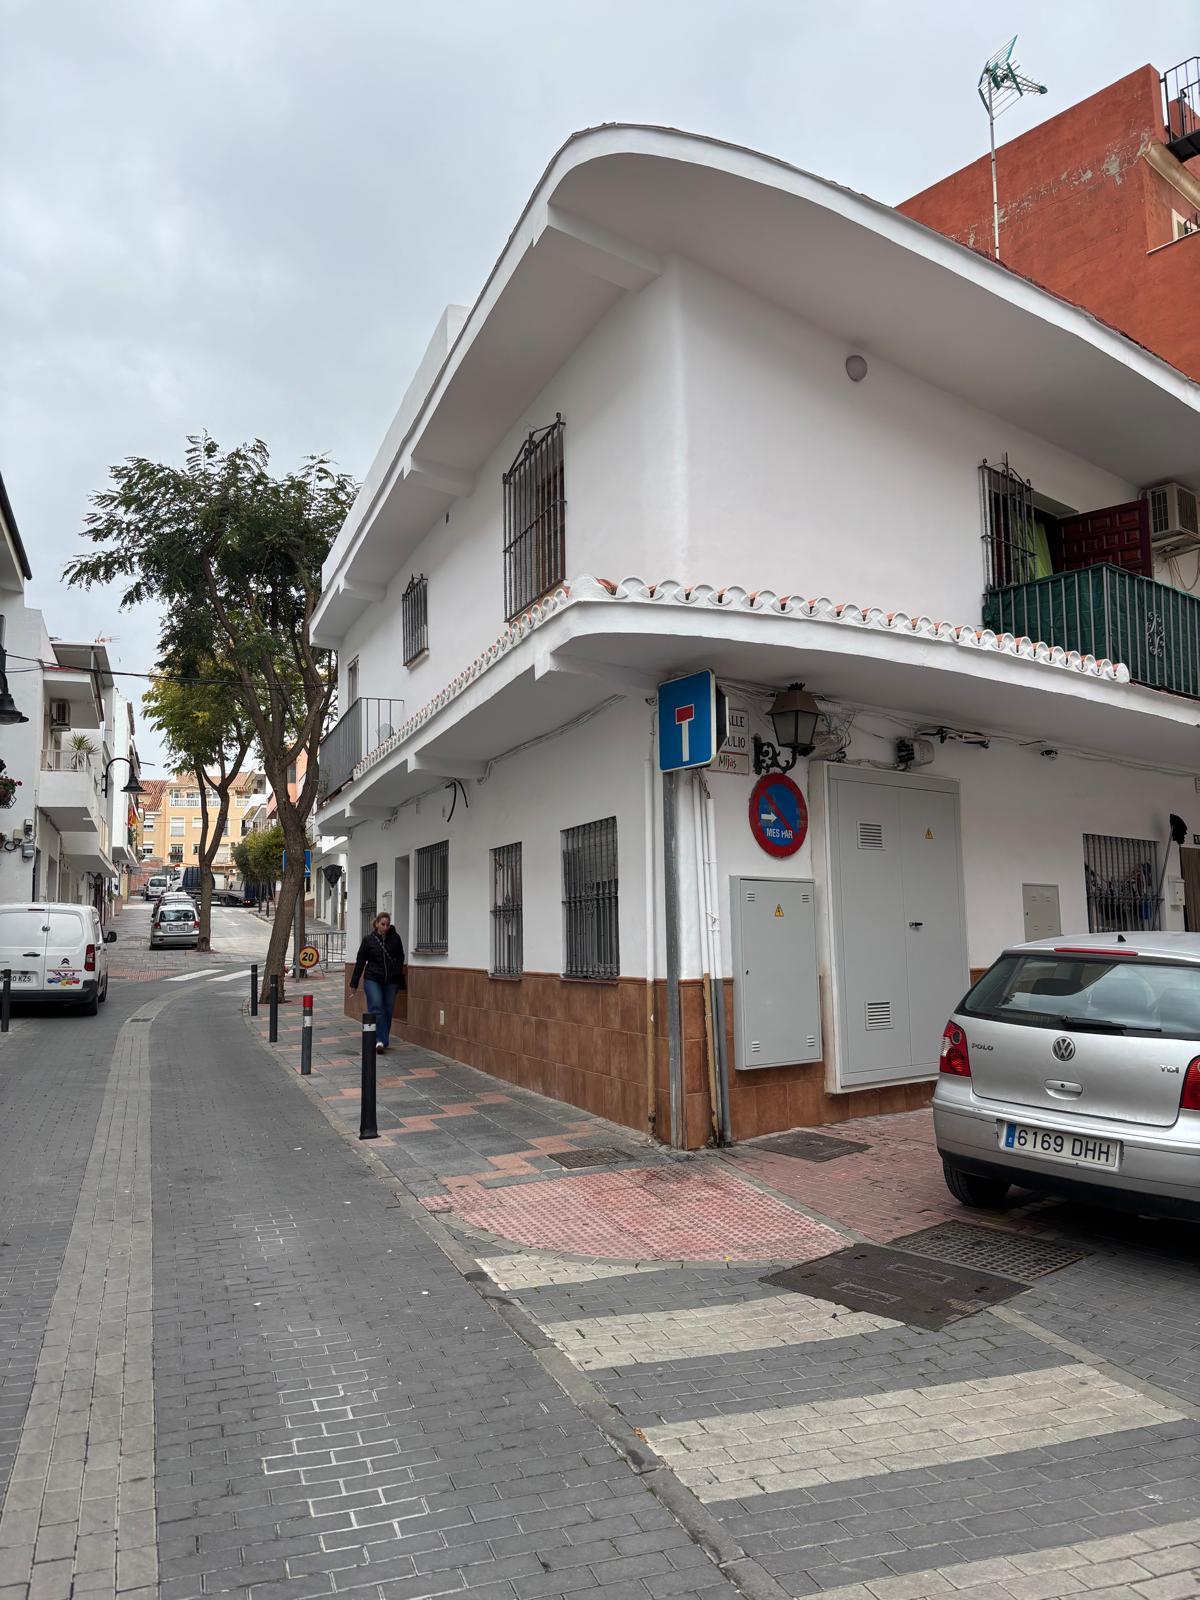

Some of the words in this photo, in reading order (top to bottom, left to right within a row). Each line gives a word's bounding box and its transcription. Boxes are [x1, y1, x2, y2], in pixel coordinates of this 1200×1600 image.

[766, 827, 780, 838] MES
[302, 951, 314, 961] 20
[971, 1042, 994, 1051] POLO
[1160, 1064, 1180, 1074] TDI
[1017, 1129, 1065, 1153] 6169
[1071, 1138, 1111, 1162] DHH
